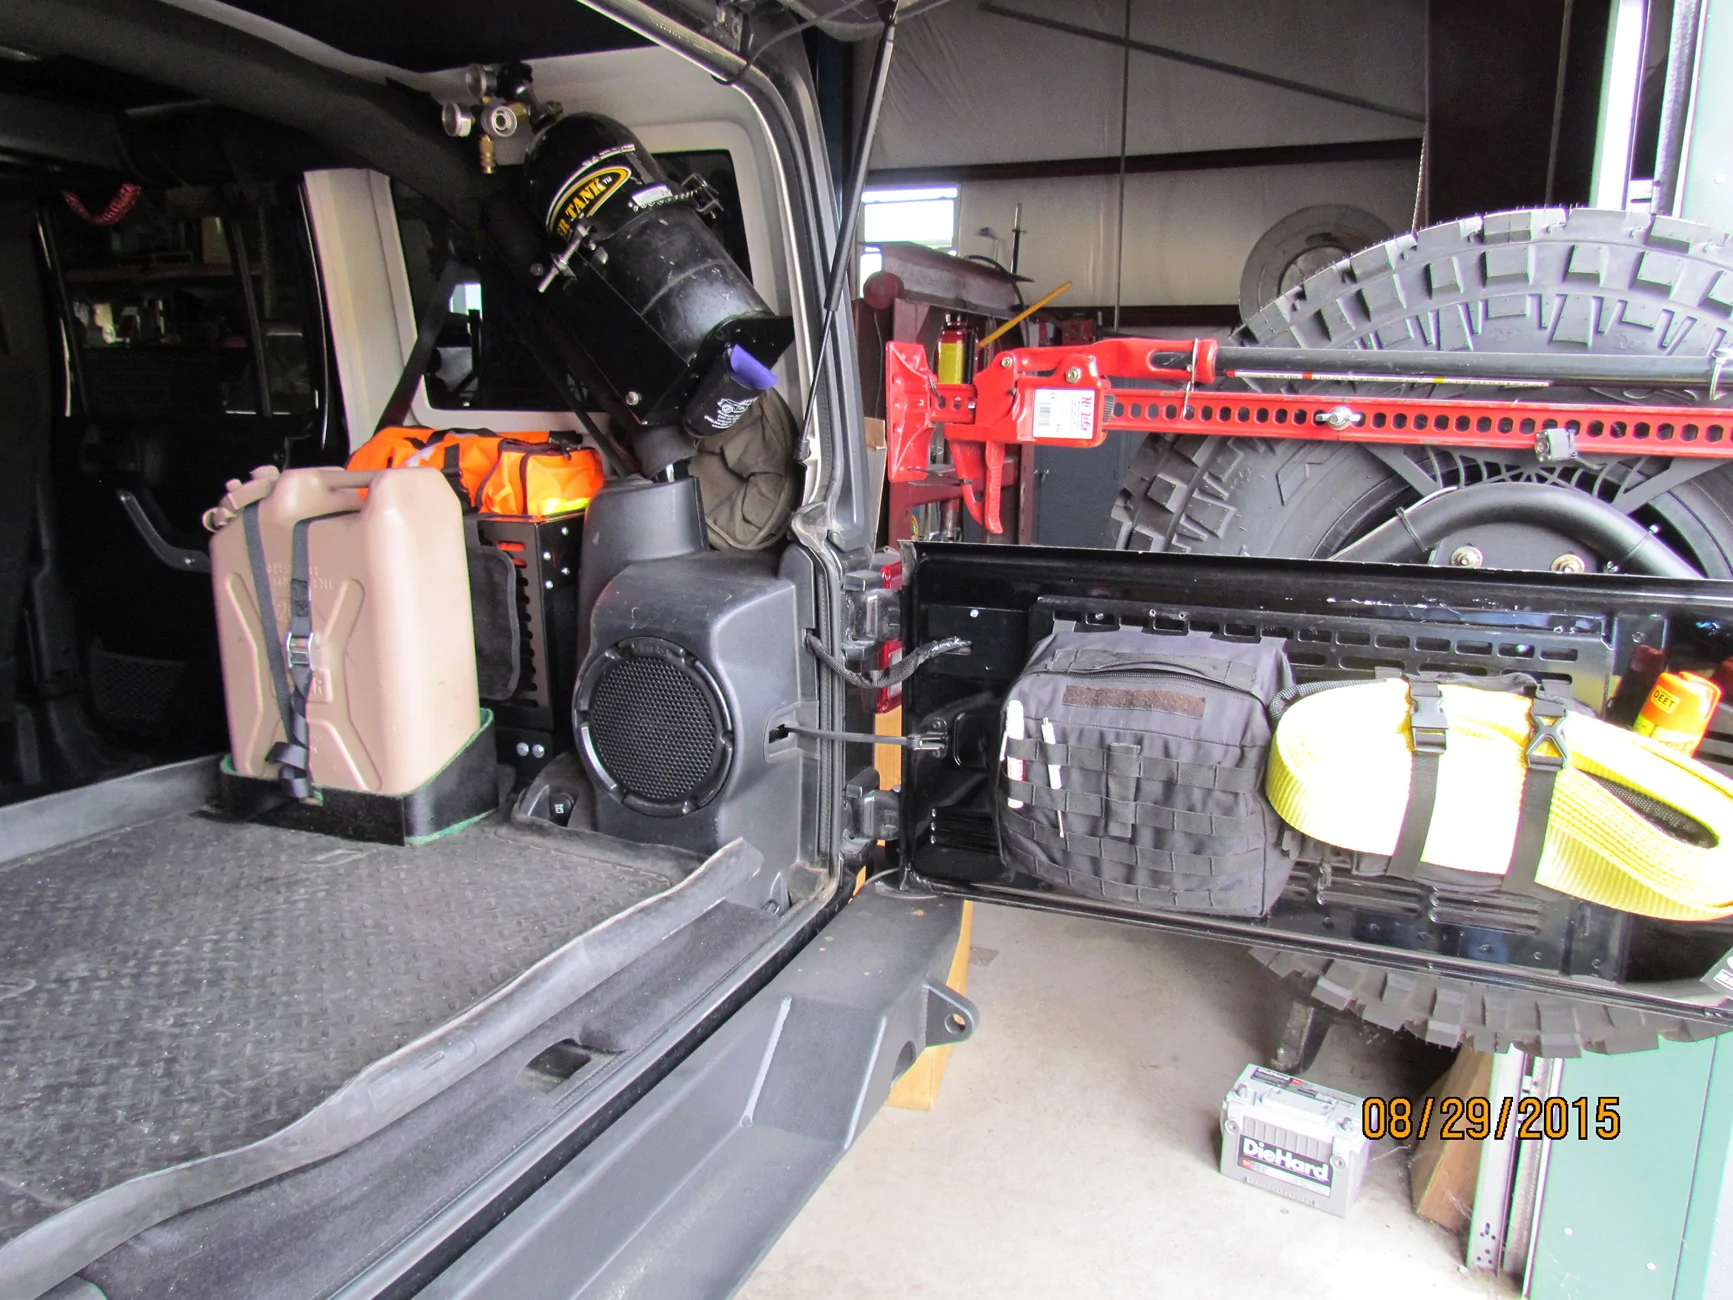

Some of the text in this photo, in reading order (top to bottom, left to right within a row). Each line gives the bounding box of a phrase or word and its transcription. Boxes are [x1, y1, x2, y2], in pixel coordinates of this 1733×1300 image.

[565, 178, 606, 219] TANK
[1653, 690, 1676, 708] DEET
[1243, 1137, 1329, 1181] DieHard
